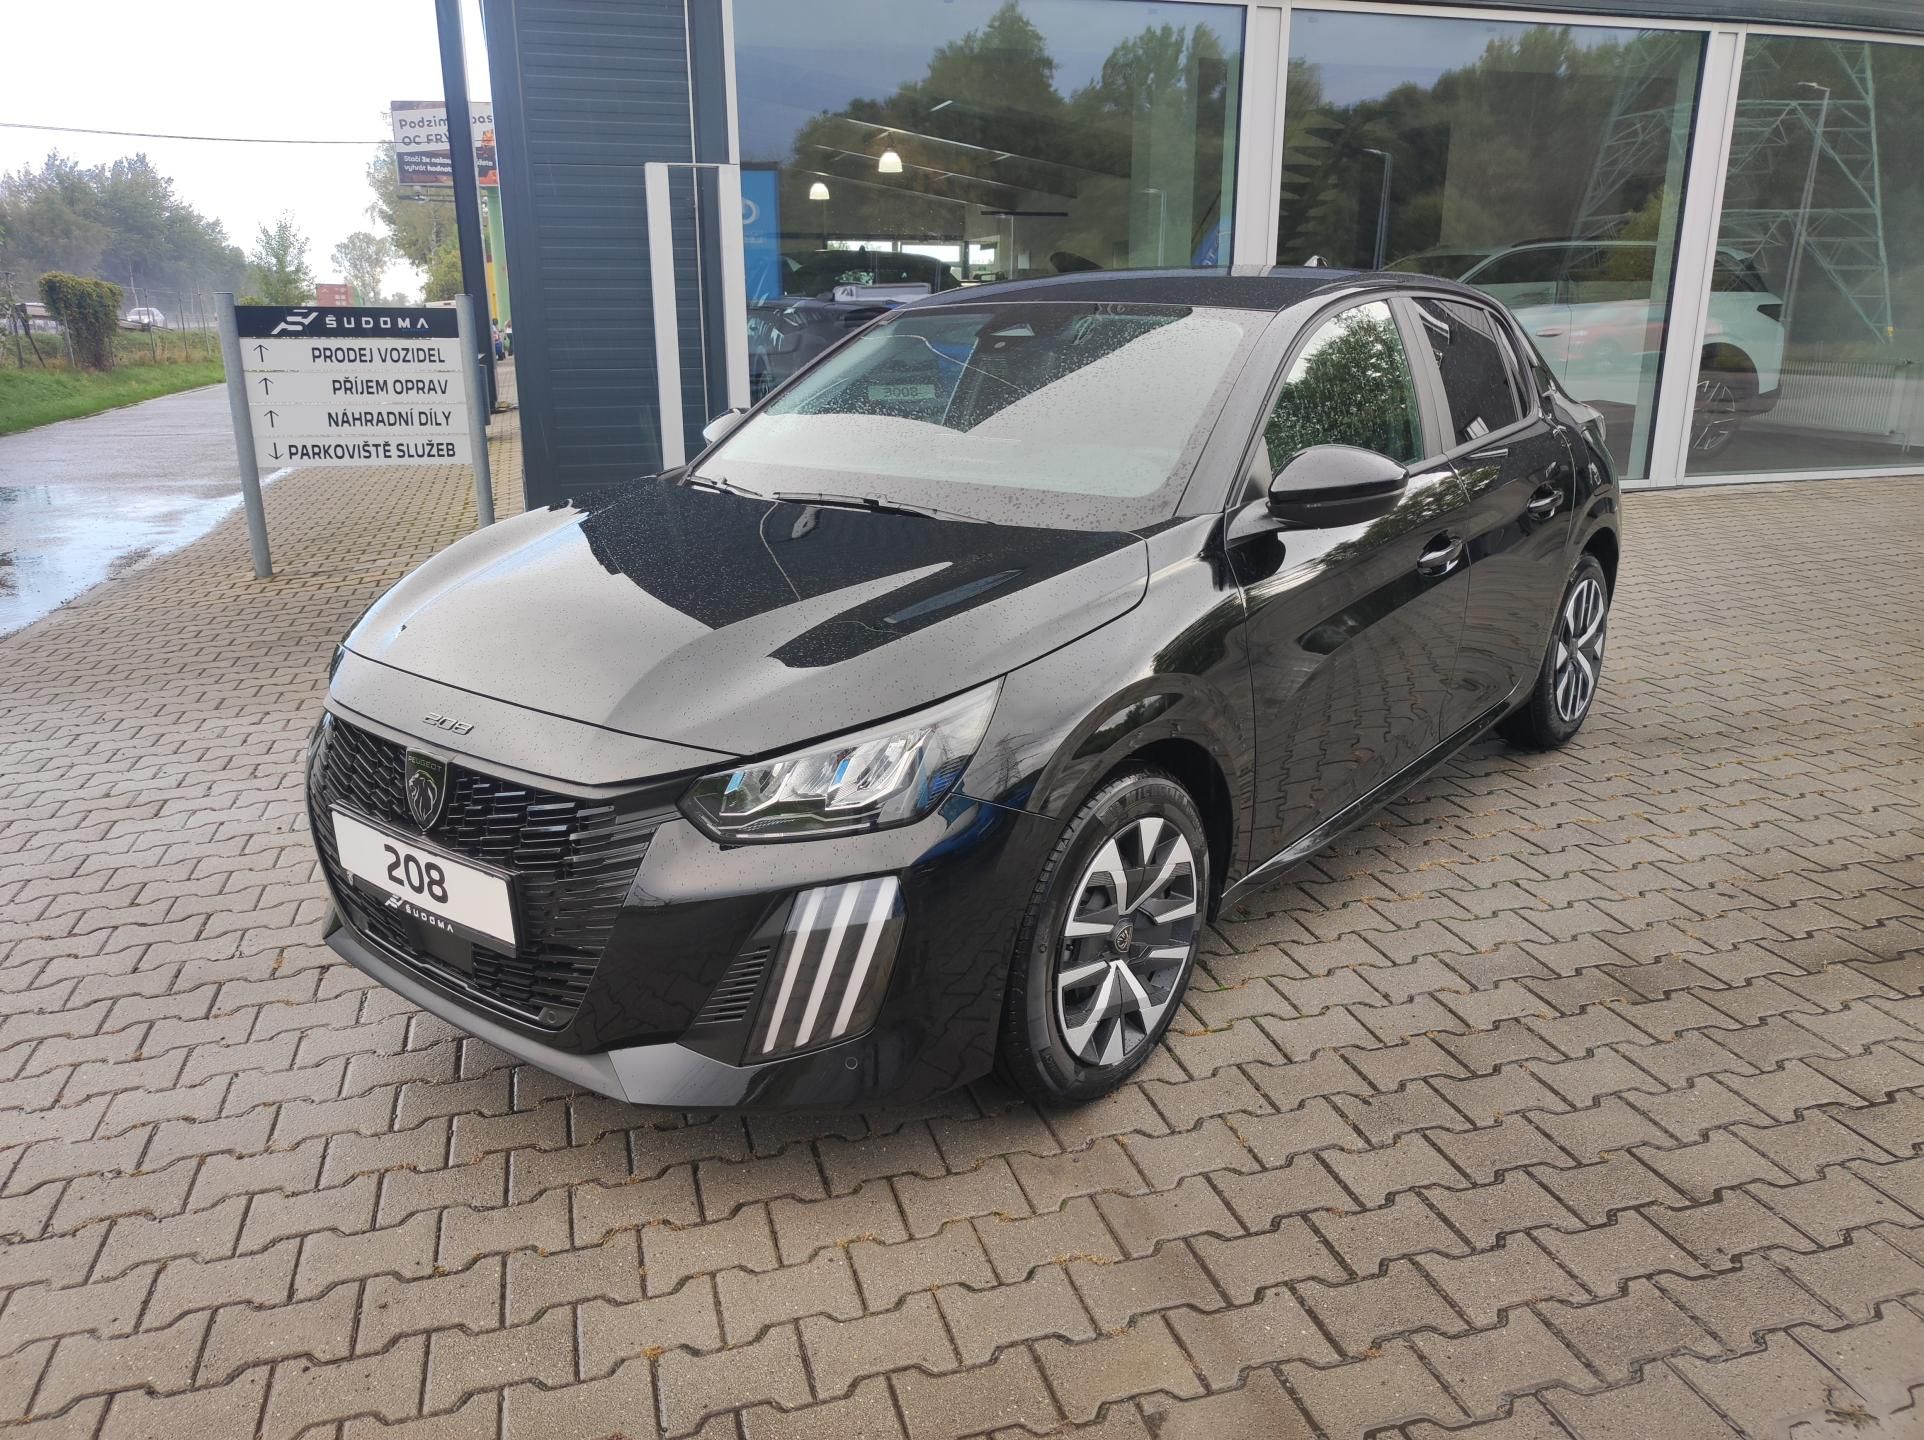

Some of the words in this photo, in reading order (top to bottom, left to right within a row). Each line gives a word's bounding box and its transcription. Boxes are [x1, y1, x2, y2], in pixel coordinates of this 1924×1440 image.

[402, 134, 421, 146] OC
[325, 314, 429, 329] ŠUDOMA
[312, 347, 373, 363] PRODEJ
[377, 347, 445, 363] VOZIDEL
[332, 377, 389, 395] PŘÍJEM
[393, 379, 448, 395] OPRAV
[328, 409, 414, 427] NÁHRADNÍ
[419, 409, 451, 427] DÍLY
[288, 441, 392, 459] PARKOVIŠTĚ
[396, 440, 456, 458] SLUŽEB
[422, 712, 474, 735] 208
[408, 755, 442, 772] PEUGEOT
[384, 843, 449, 904] 208
